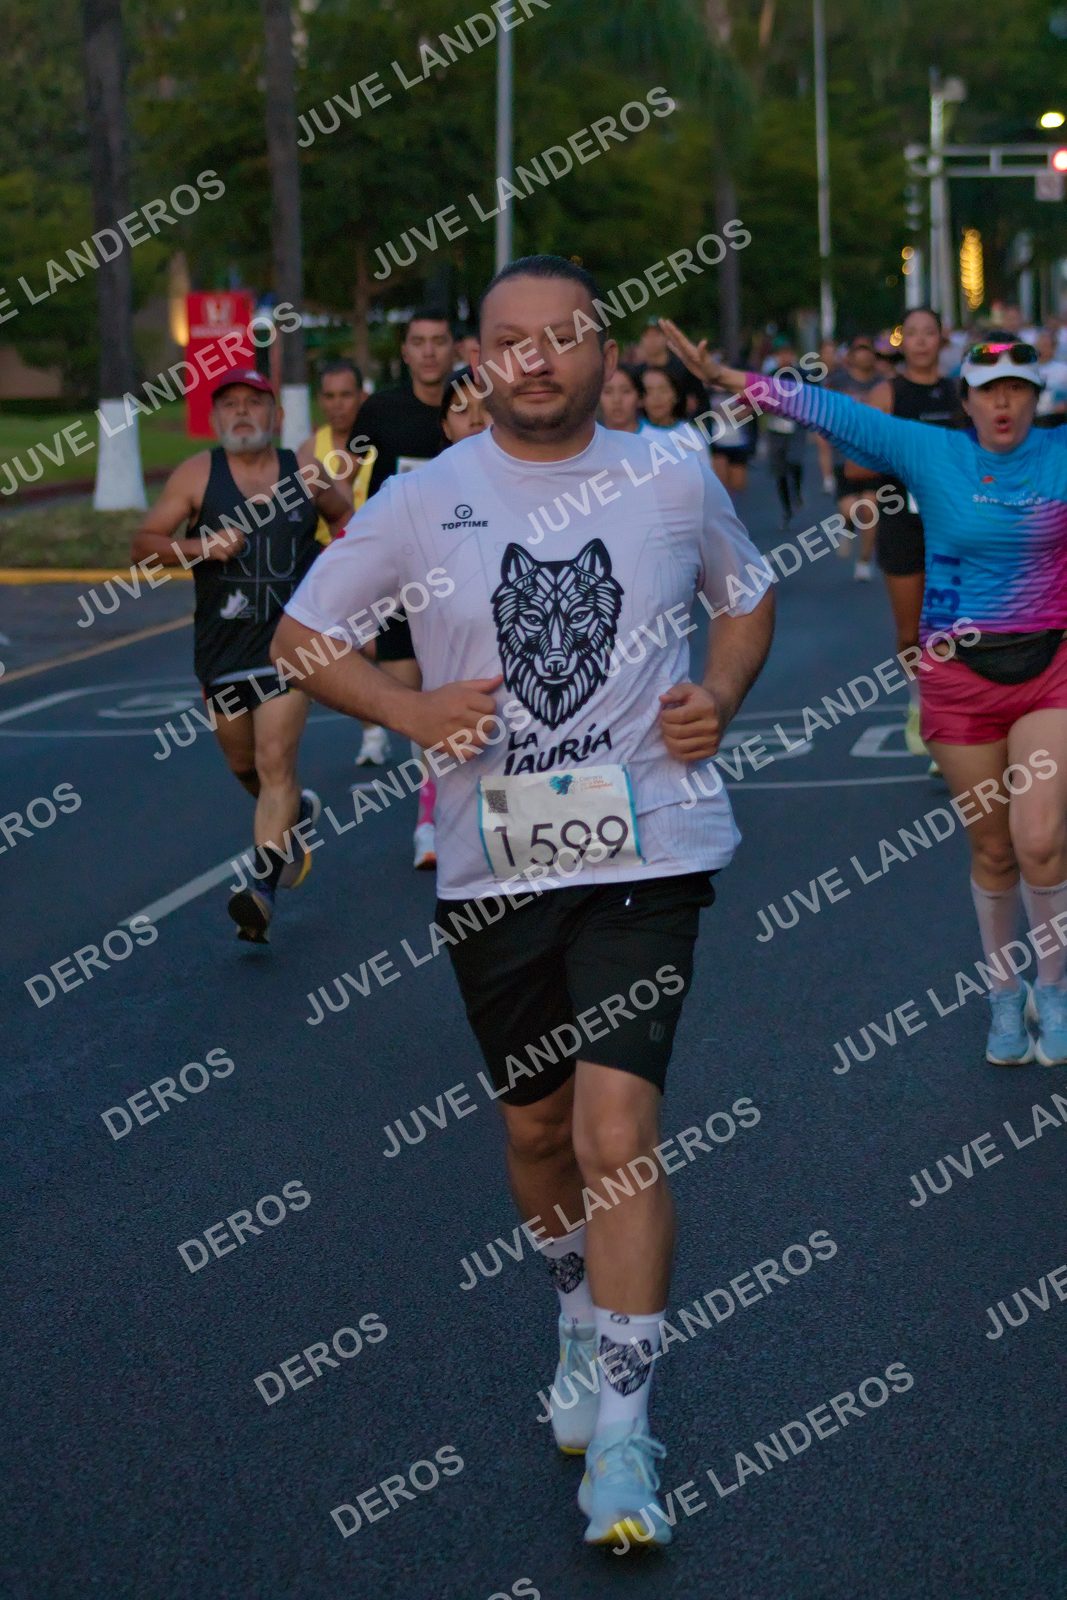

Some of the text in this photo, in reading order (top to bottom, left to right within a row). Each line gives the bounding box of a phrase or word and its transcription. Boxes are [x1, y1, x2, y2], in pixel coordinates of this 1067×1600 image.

[441, 520, 488, 531] TOPTIME
[507, 731, 538, 751] LA
[493, 815, 629, 867] 1599
